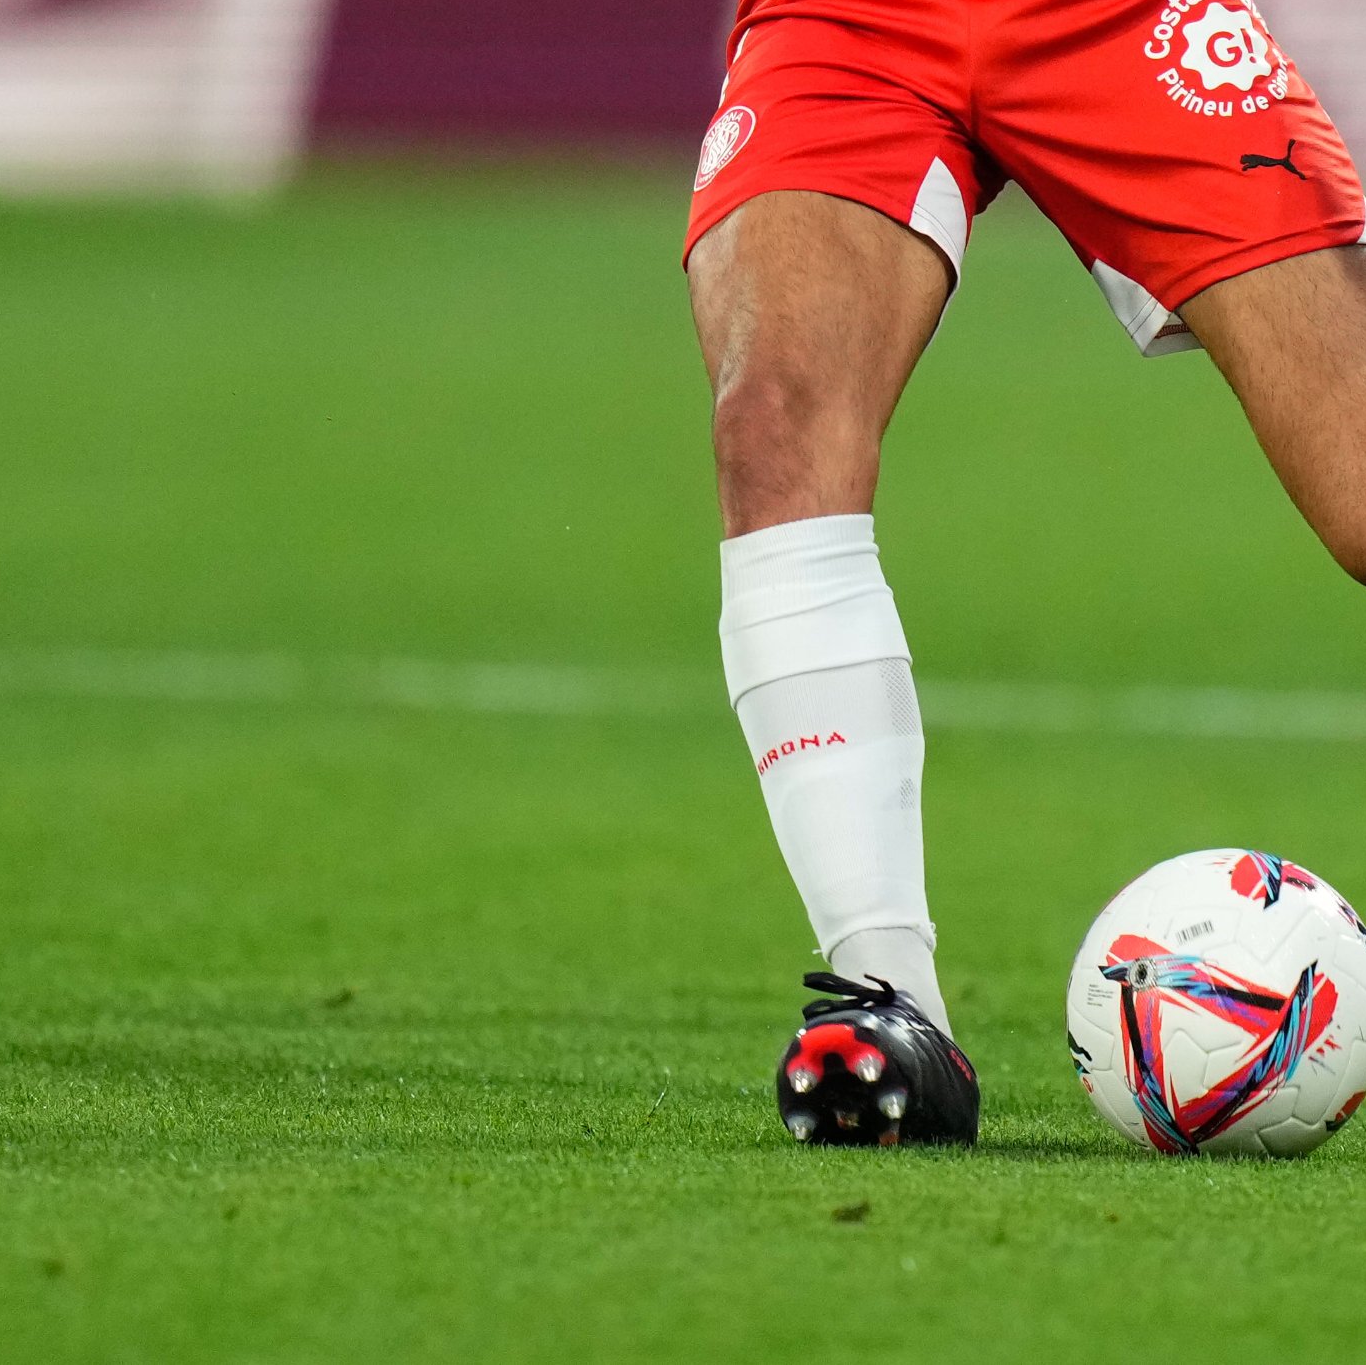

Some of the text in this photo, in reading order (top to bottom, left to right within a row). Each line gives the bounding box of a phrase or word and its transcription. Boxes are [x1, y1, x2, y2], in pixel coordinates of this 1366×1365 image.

[1206, 28, 1257, 67] G!
[1156, 47, 1289, 116] Pirineu de Giron
[757, 731, 846, 776] GIRONA
